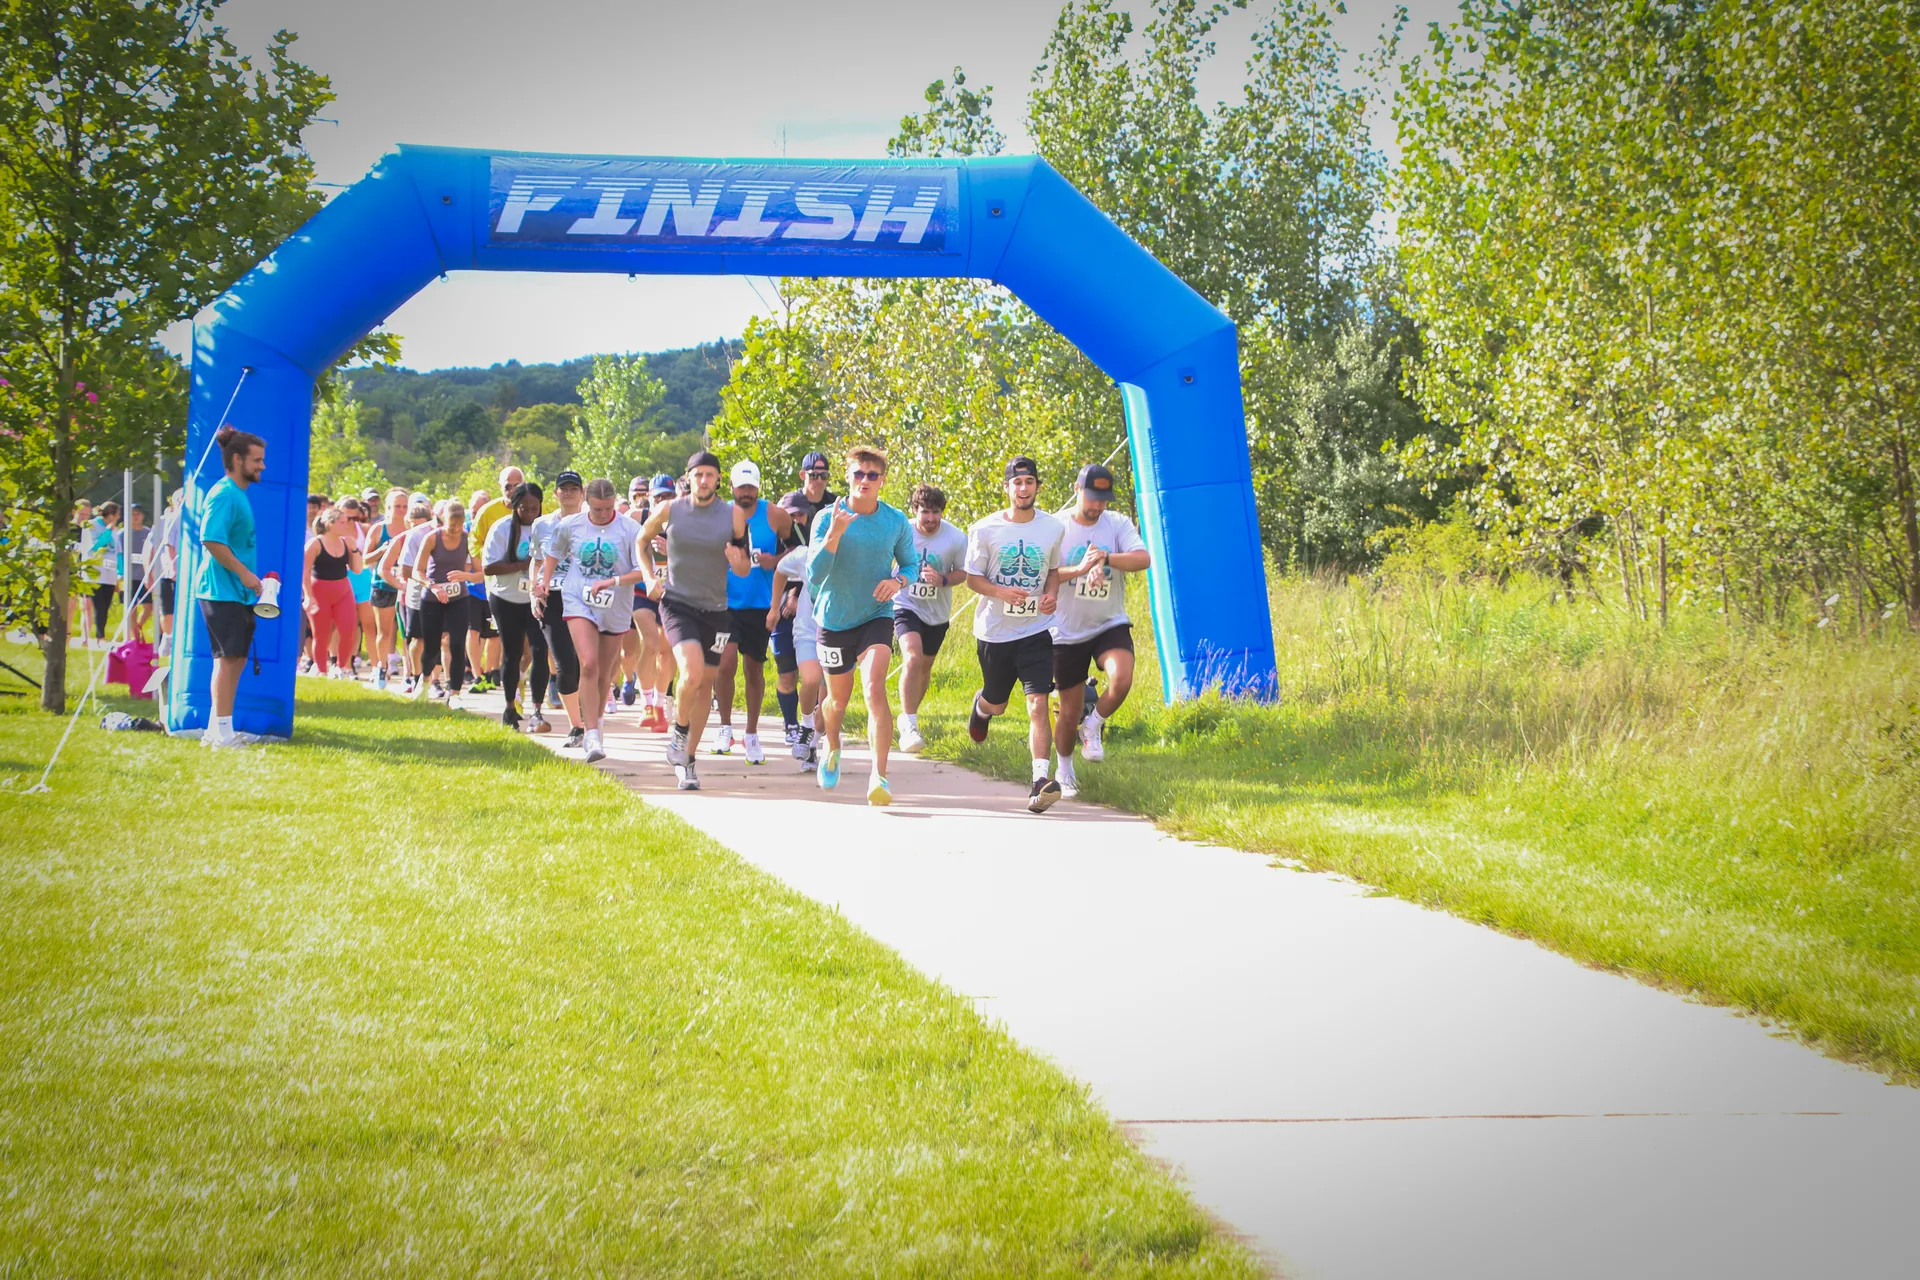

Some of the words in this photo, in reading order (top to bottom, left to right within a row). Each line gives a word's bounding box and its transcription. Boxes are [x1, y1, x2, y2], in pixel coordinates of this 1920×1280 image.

[495, 175, 942, 244] FINISH
[585, 590, 612, 606] 167
[911, 584, 936, 598] 103
[1078, 583, 1108, 598] 165
[1006, 600, 1036, 614] 134
[824, 650, 840, 665] 19
